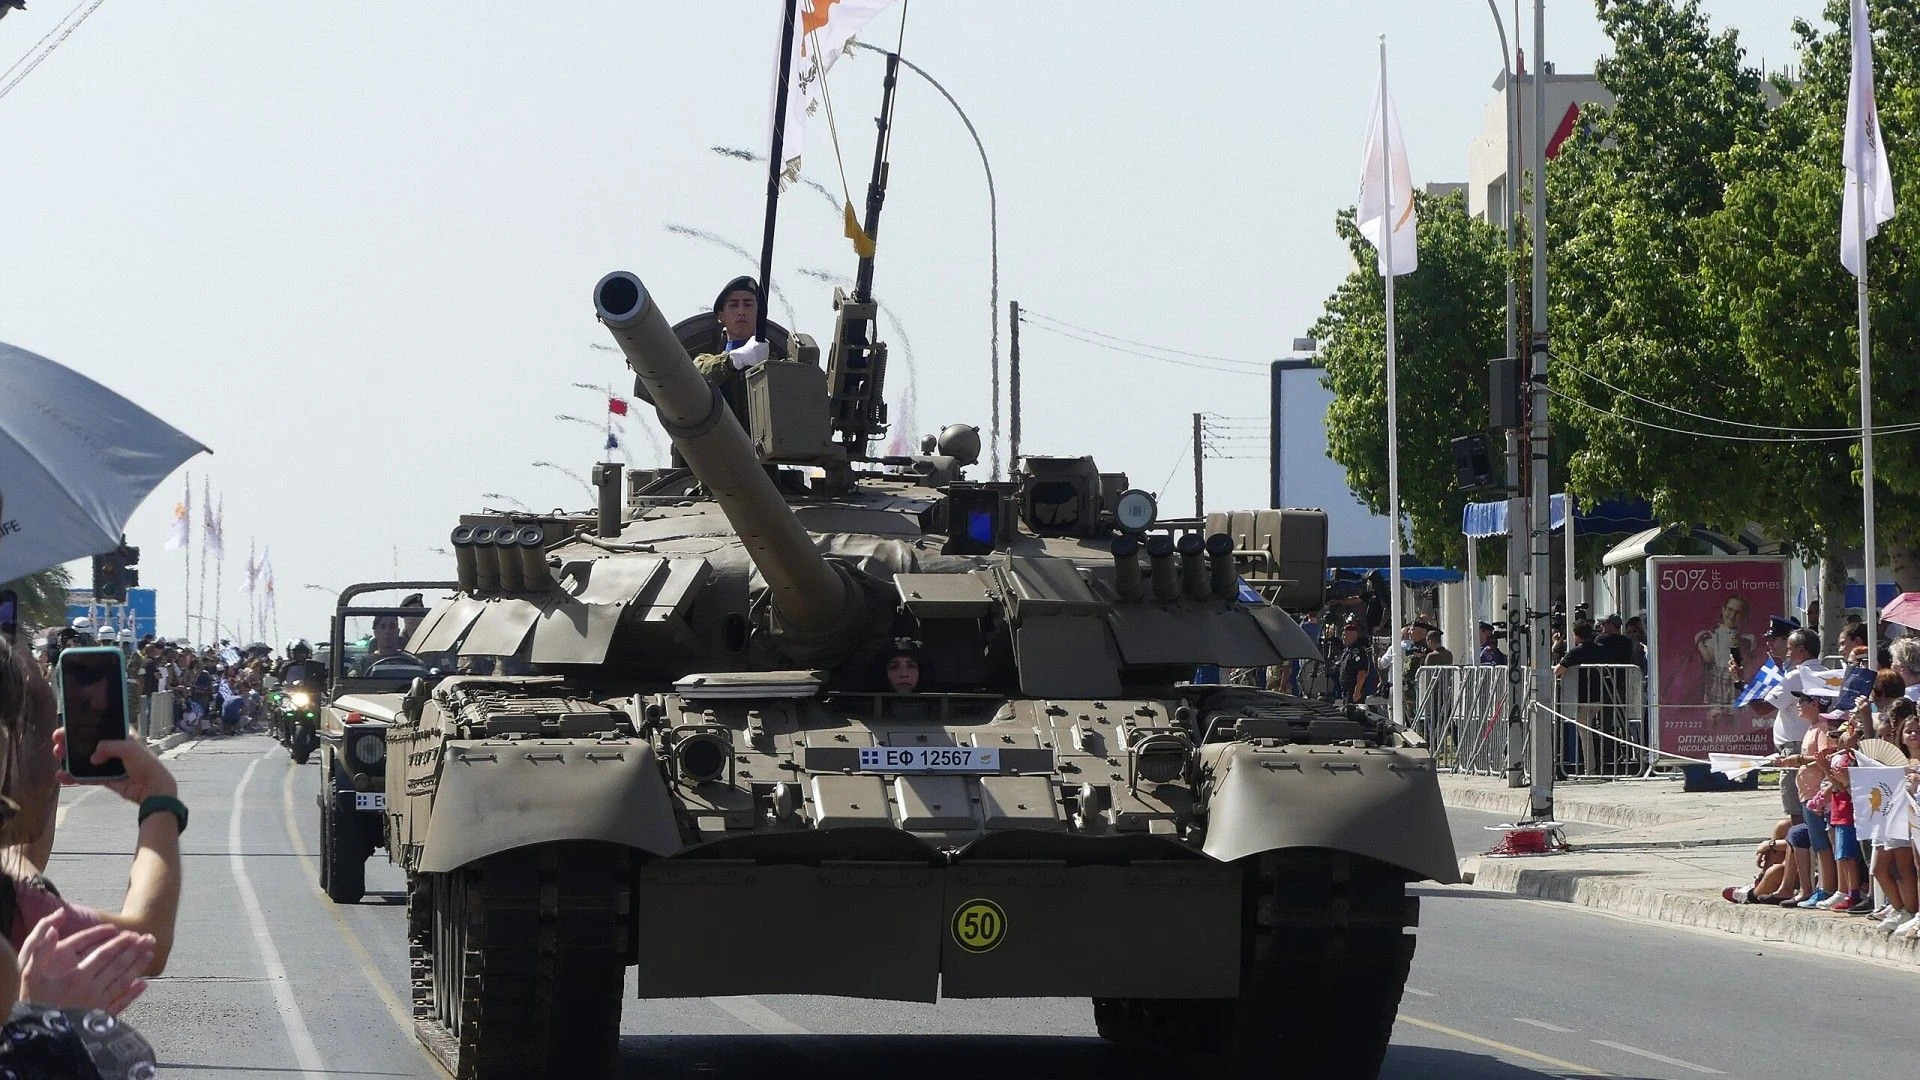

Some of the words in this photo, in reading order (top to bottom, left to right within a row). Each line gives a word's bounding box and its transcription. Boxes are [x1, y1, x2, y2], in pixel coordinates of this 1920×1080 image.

[1661, 569, 1709, 591] 50%
[1712, 569, 1721, 590] OFF
[1725, 580, 1739, 590] all
[1742, 580, 1782, 590] frames
[1678, 735, 1713, 744] ΟΠΤΙΚΑ
[1715, 734, 1768, 743] ΝΙΚΟΛΑΙΔΗ
[1678, 744, 1725, 752] NICOLAIDES
[1727, 744, 1768, 752] OPTICIANS
[886, 750, 914, 766] ΕΦ
[920, 750, 972, 766] 12567
[963, 912, 995, 940] 50
